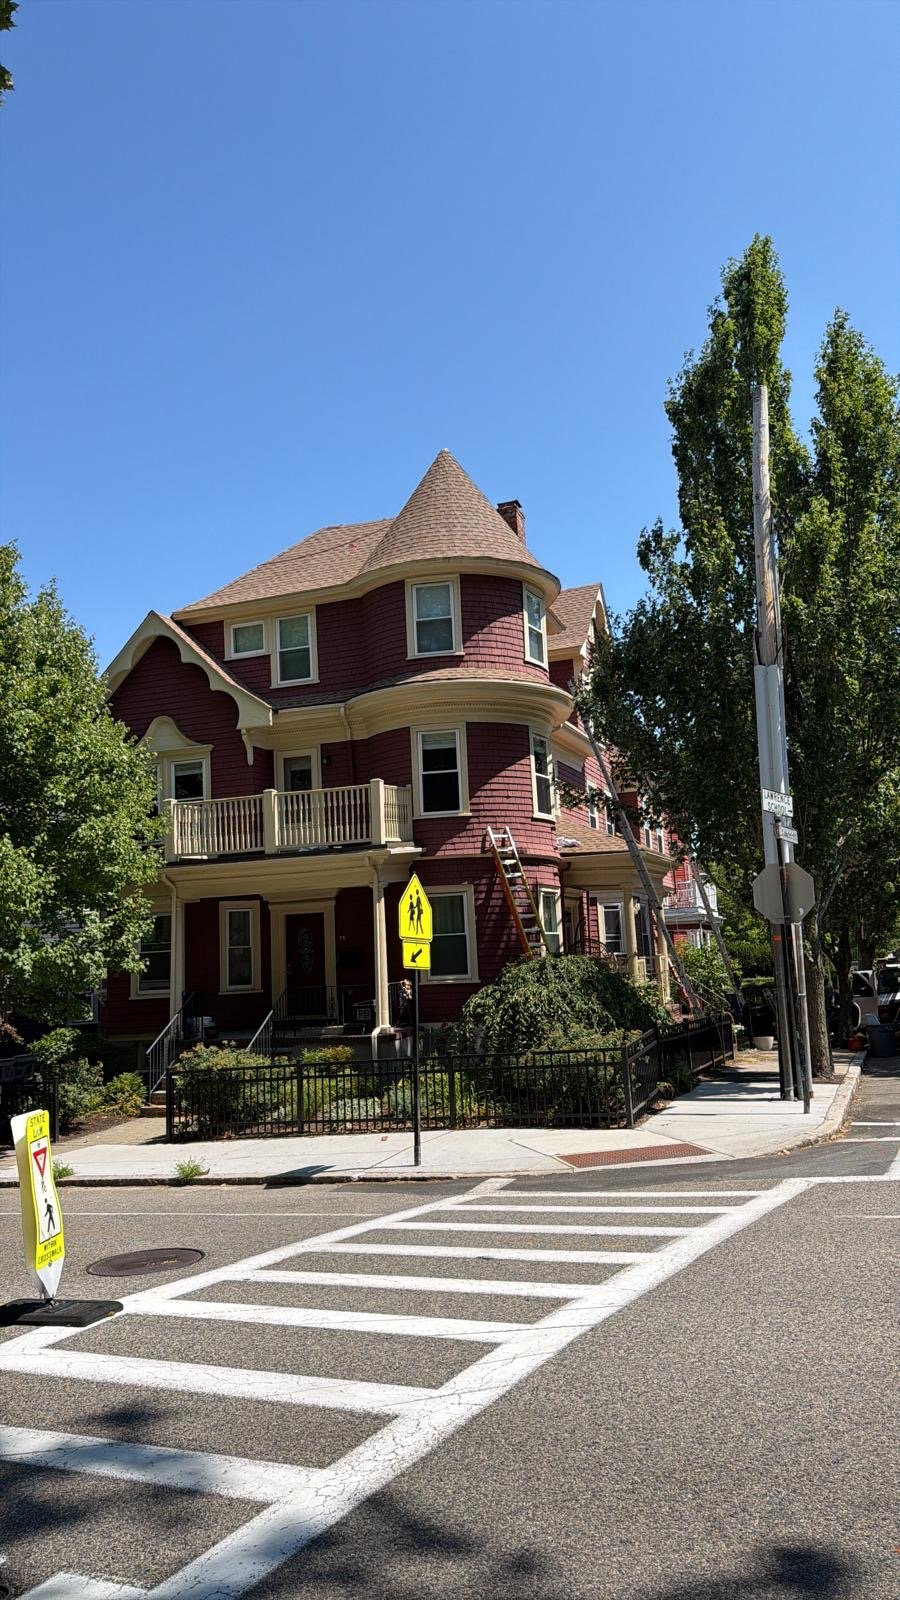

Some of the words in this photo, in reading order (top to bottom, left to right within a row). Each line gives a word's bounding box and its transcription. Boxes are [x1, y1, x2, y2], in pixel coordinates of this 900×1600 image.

[764, 790, 791, 805] LAWRENCE
[768, 801, 787, 815] SCHOOL
[30, 1113, 45, 1128] STATE
[33, 1126, 43, 1138] LAW
[44, 1240, 57, 1252] WITHIN
[38, 1246, 62, 1265] CROSSWALK
